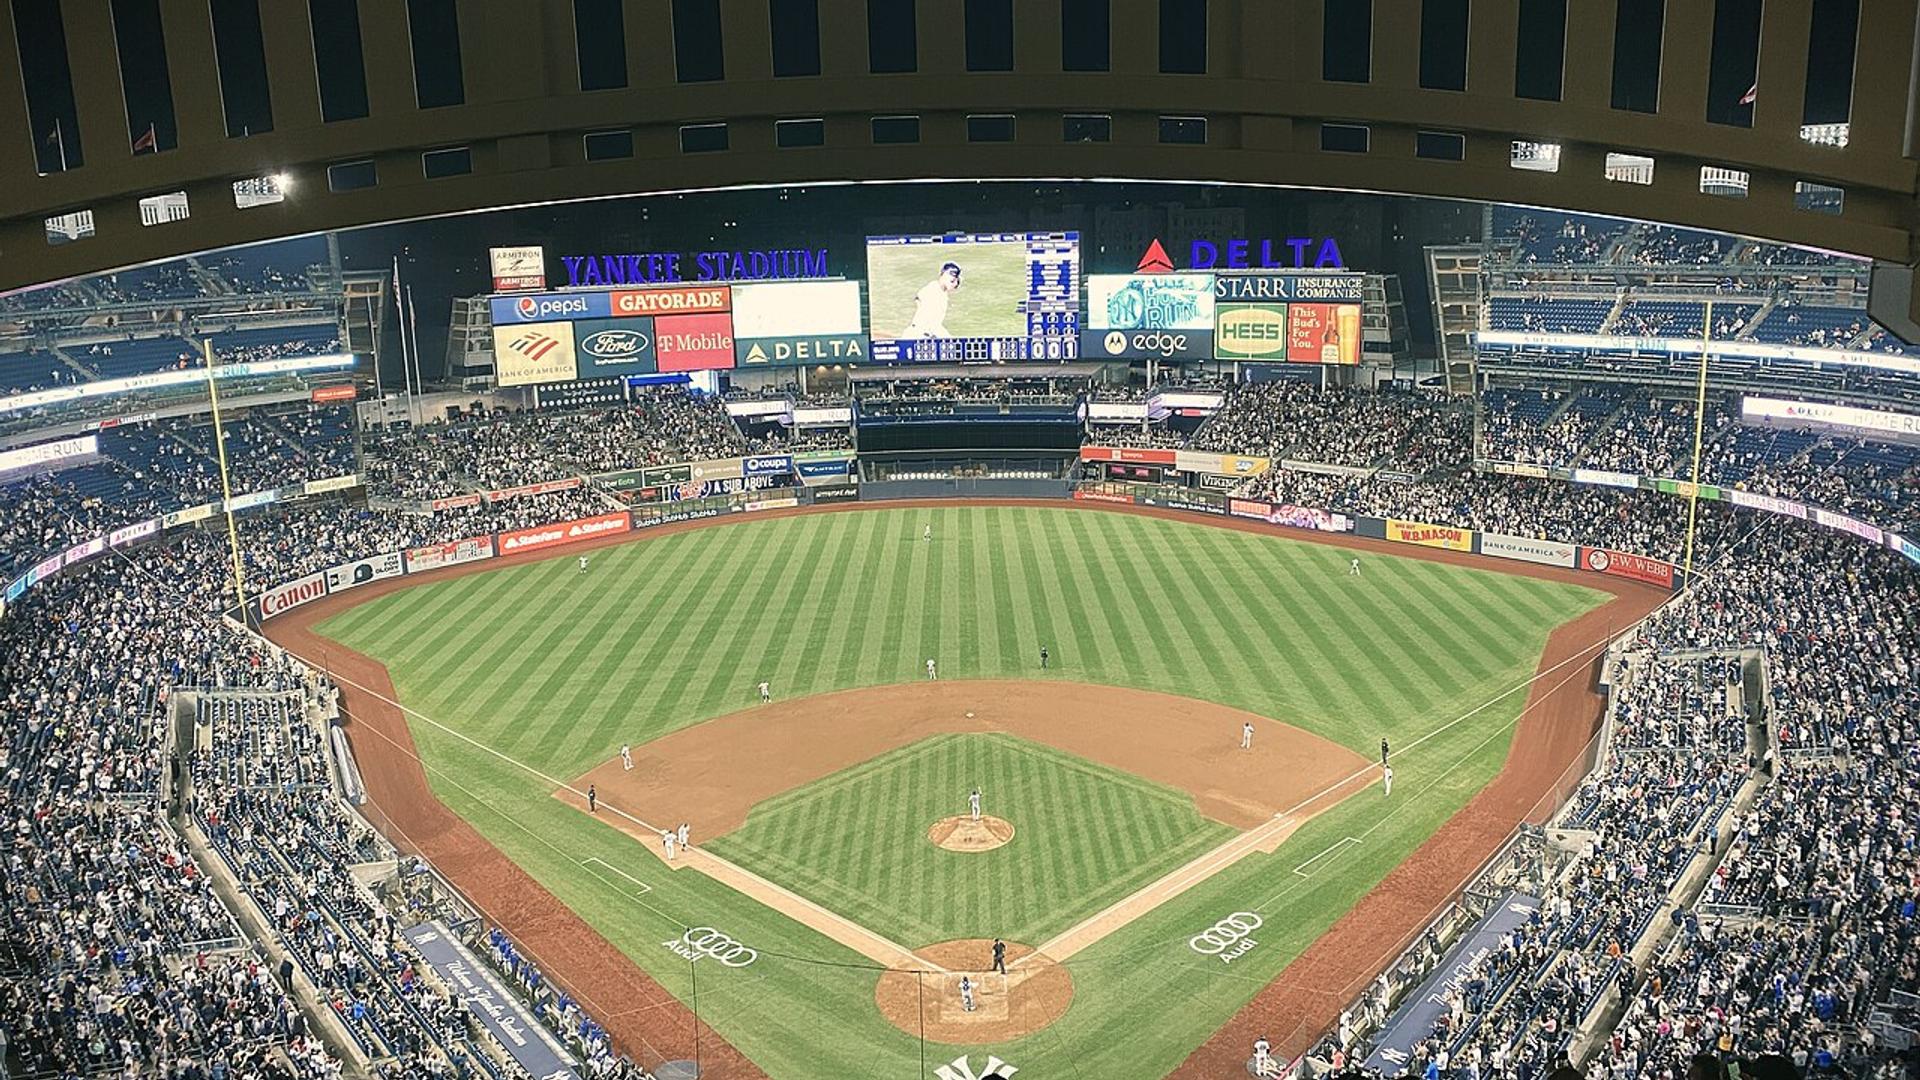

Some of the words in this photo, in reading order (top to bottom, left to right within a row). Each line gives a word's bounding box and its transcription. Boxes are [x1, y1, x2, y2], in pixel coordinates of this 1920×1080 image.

[496, 250, 540, 259] ARMITRON
[1190, 236, 1344, 269] DELTA
[561, 253, 682, 286] YANKEE
[697, 249, 828, 281] STADIUM
[1216, 278, 1289, 298] STARR
[1296, 278, 1363, 288] INSURANCE
[619, 291, 724, 312] GATORADE
[1296, 288, 1362, 298] COMPANIES
[1147, 302, 1197, 330] RUN
[1293, 306, 1317, 317] This
[1223, 323, 1279, 340] HESS
[1293, 318, 1321, 328] Bud's
[1293, 328, 1310, 338] For
[594, 333, 637, 353] Ford
[775, 339, 862, 360] DELTA
[1132, 331, 1187, 357] edge
[1292, 338, 1315, 349] You.
[500, 371, 523, 379] BANK
[524, 368, 536, 376] OF
[536, 365, 574, 375] AMERICA
[53, 441, 83, 456] RUN
[759, 458, 787, 470] coupa
[713, 481, 722, 493] A
[723, 478, 743, 493] SUB
[744, 475, 774, 491] ABOVE
[1202, 475, 1239, 488] VIKING
[1736, 493, 1775, 511] HOME
[1777, 501, 1806, 520] RUN
[1823, 511, 1857, 532] HOME
[122, 525, 148, 539] DELTA
[1484, 541, 1506, 550] BANK
[1506, 543, 1517, 551] OF
[1518, 544, 1555, 557] AMERICA
[1610, 553, 1632, 568] F.W.
[1635, 558, 1668, 577] WEBB
[262, 578, 324, 615] Canon
[662, 940, 705, 962] Audi
[1219, 937, 1259, 964] Audi
